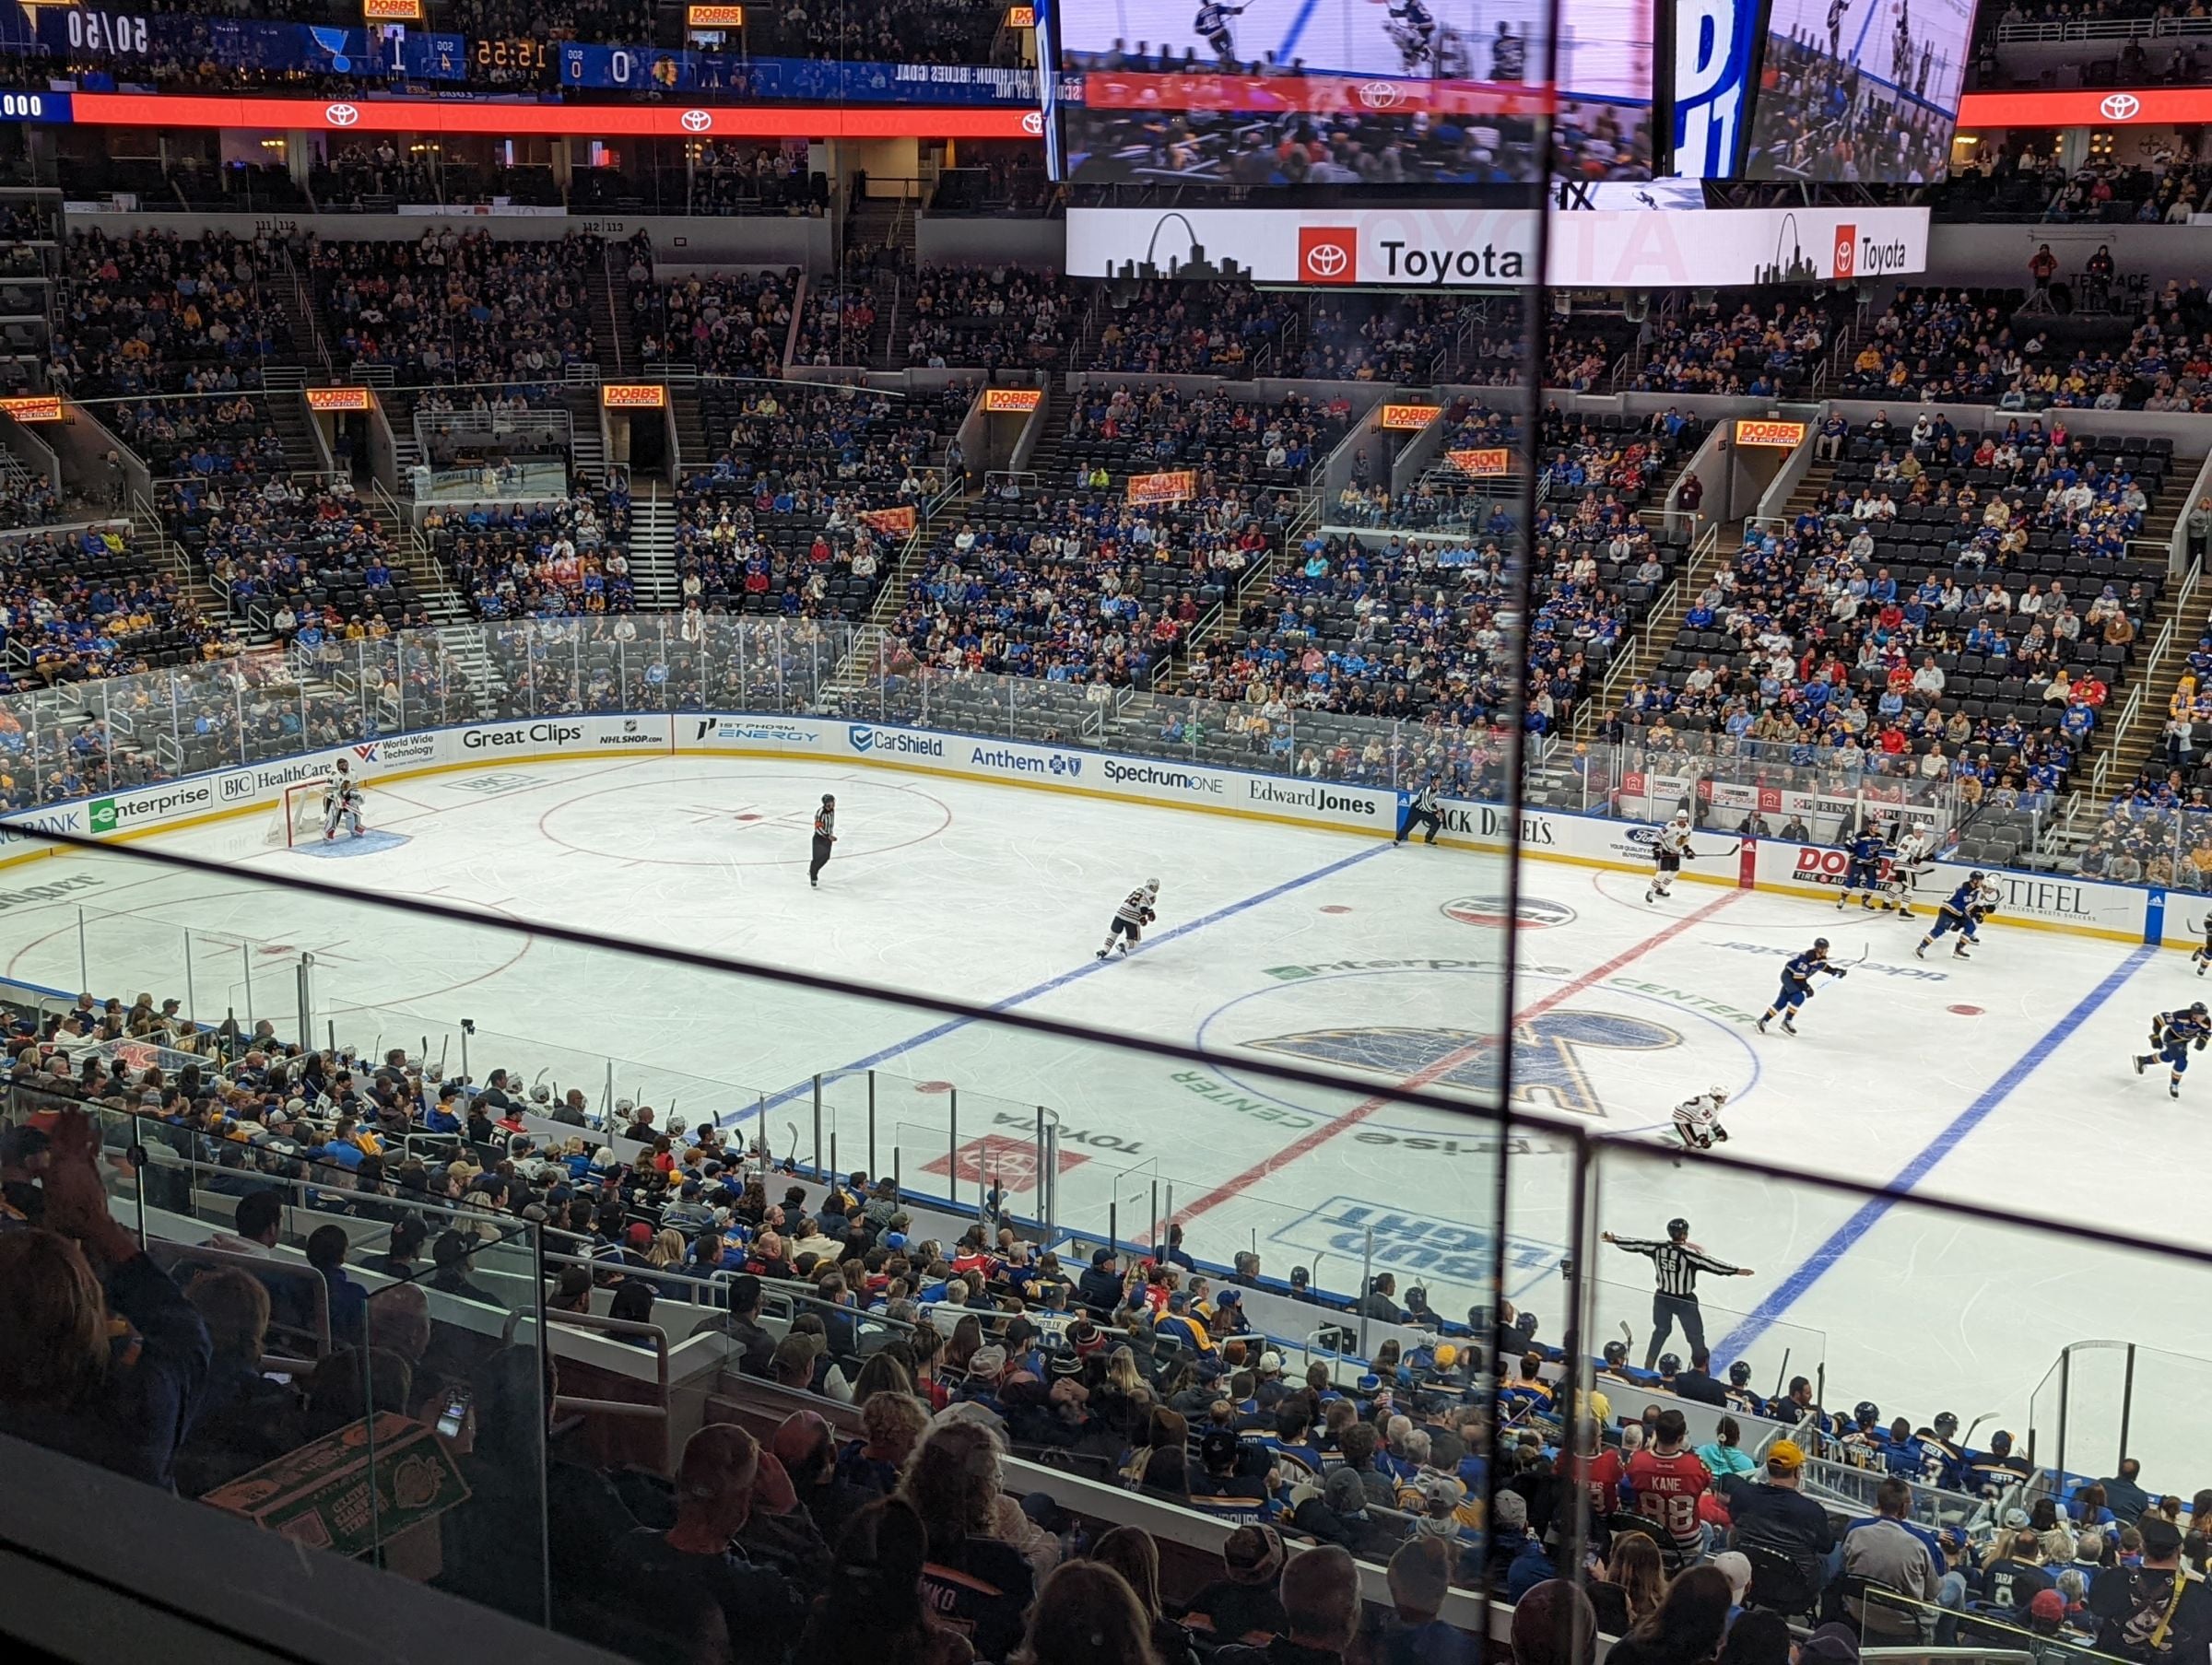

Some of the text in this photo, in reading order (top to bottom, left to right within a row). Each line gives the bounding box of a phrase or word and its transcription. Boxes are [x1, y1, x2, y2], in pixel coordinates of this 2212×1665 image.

[368, 0, 417, 10] DOBBS
[692, 8, 738, 18] DOBBS
[279, 220, 296, 231] 112
[582, 222, 623, 232] 112 113
[1381, 240, 1523, 284] Toyota
[1863, 237, 1905, 276] Toyota
[312, 392, 364, 402] DOBBS
[607, 388, 660, 398] DOBBS
[991, 393, 1039, 404] DOBBS
[1743, 424, 1800, 439] DOBBS
[382, 734, 434, 750] World Wide
[463, 724, 582, 748] Great Clips
[718, 729, 819, 742] ENERGY
[875, 731, 943, 757] CarShield
[382, 745, 434, 760] Technology
[971, 747, 1045, 773] Anthem
[224, 762, 332, 797] BJC HealthCare
[1104, 760, 1188, 790] Spectrum
[90, 788, 210, 822] enterprise
[1249, 780, 1376, 815] Edward Jones
[1806, 801, 1852, 815] PURINA
[1422, 806, 1473, 834] ACK
[1886, 810, 1933, 824] PURINA
[1795, 872, 1817, 881] TIRE
[1609, 977, 1759, 1025] CENTER
[1171, 1069, 1314, 1130] CENTER
[1327, 1232, 1496, 1282] BUD
[1661, 1258, 1677, 1271] 56
[1652, 1476, 1682, 1491] KANE
